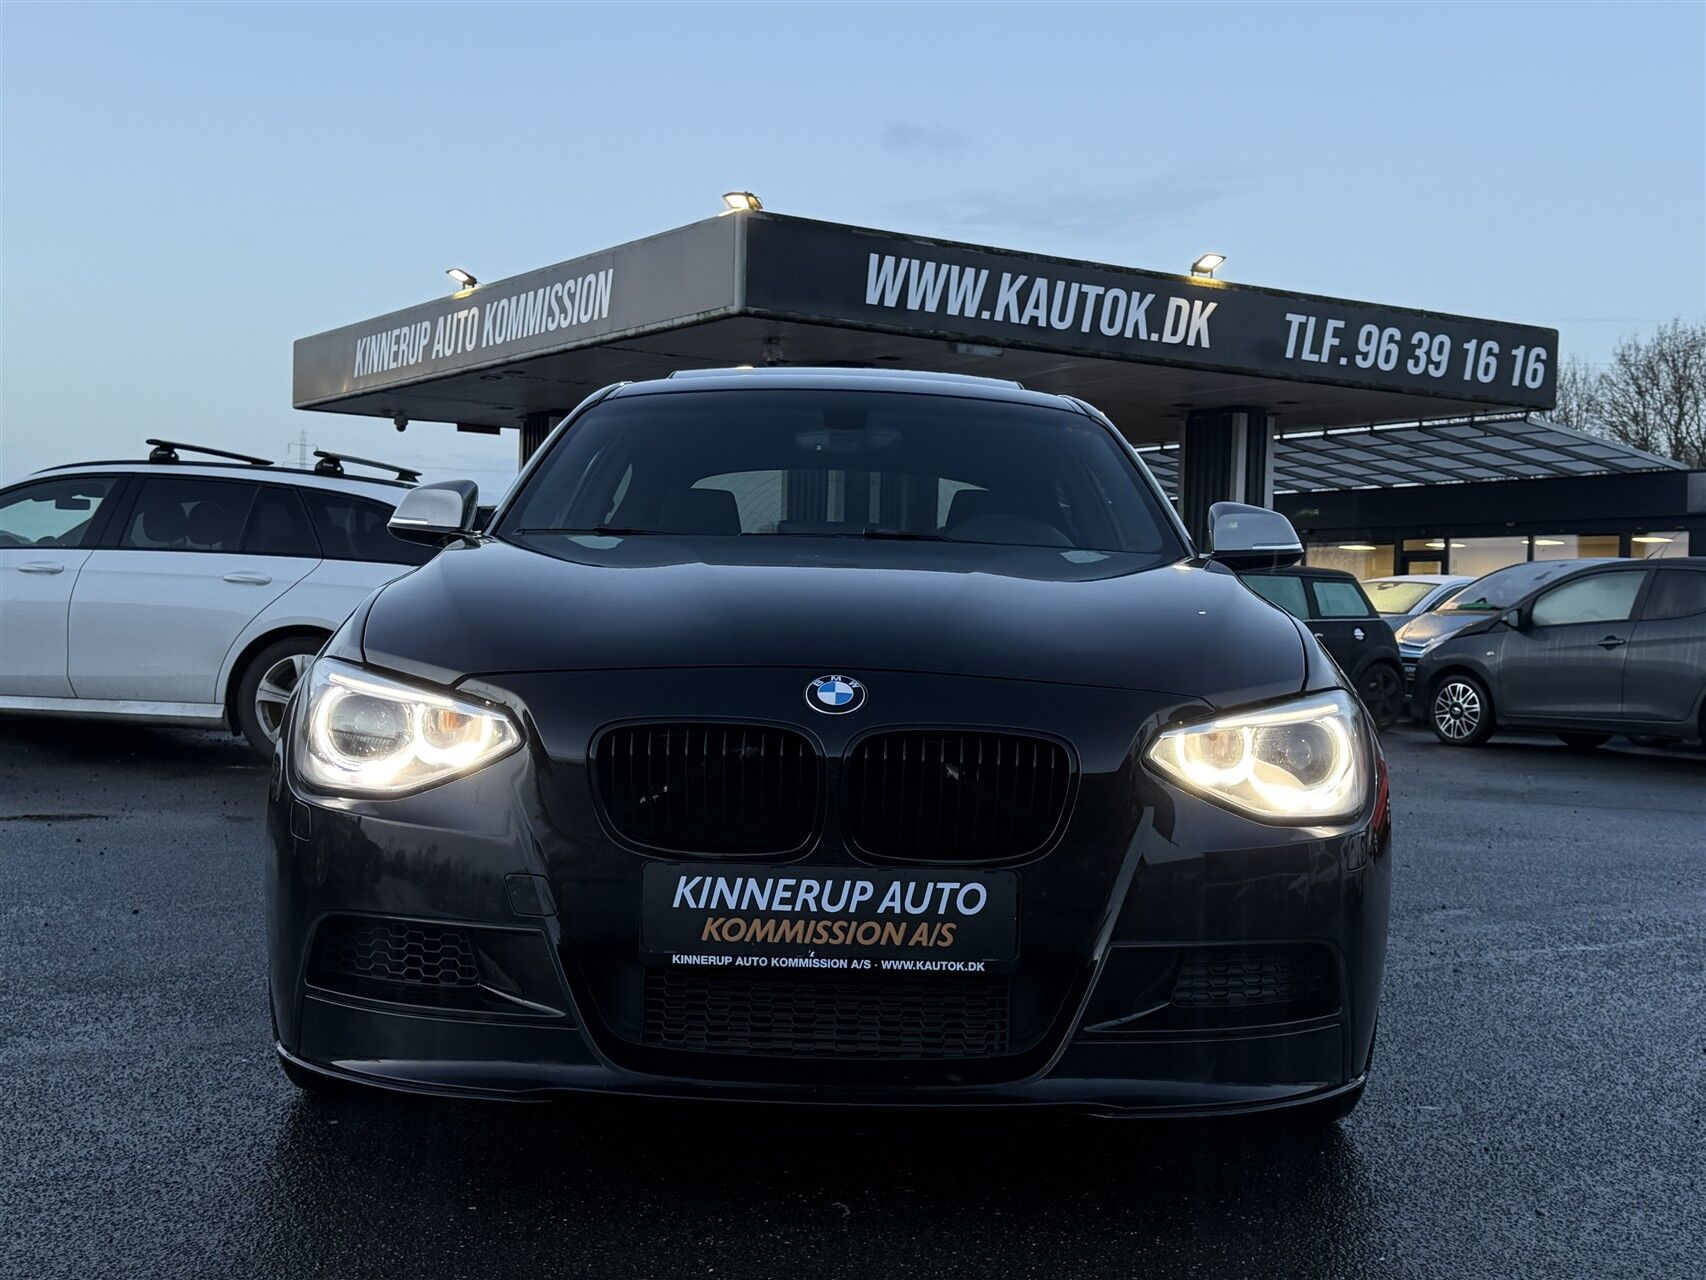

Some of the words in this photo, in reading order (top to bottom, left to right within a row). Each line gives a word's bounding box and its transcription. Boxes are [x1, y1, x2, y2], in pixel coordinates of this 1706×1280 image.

[865, 252, 1219, 349] WWW.KAUTOK.DK
[353, 320, 431, 378] KINNERUP
[431, 306, 480, 360] AUTO
[481, 268, 615, 348] KOMMISSION
[1285, 312, 1348, 366] TLF.
[1355, 323, 1401, 372] 96
[1406, 330, 1451, 378] 39
[1462, 338, 1500, 384] 16
[1511, 344, 1548, 390] 16
[812, 675, 861, 688] BMW
[672, 875, 874, 913] KINNERUP
[877, 880, 987, 916] AUTO
[701, 916, 907, 946] KOMMISSION
[907, 922, 957, 947] A/S
[672, 954, 733, 966] KINNERUP
[735, 956, 768, 967] AUTO
[771, 957, 848, 969] KOMMISSION
[850, 959, 871, 969] A/S
[881, 960, 985, 972] WWW.KAUTOK.DK
